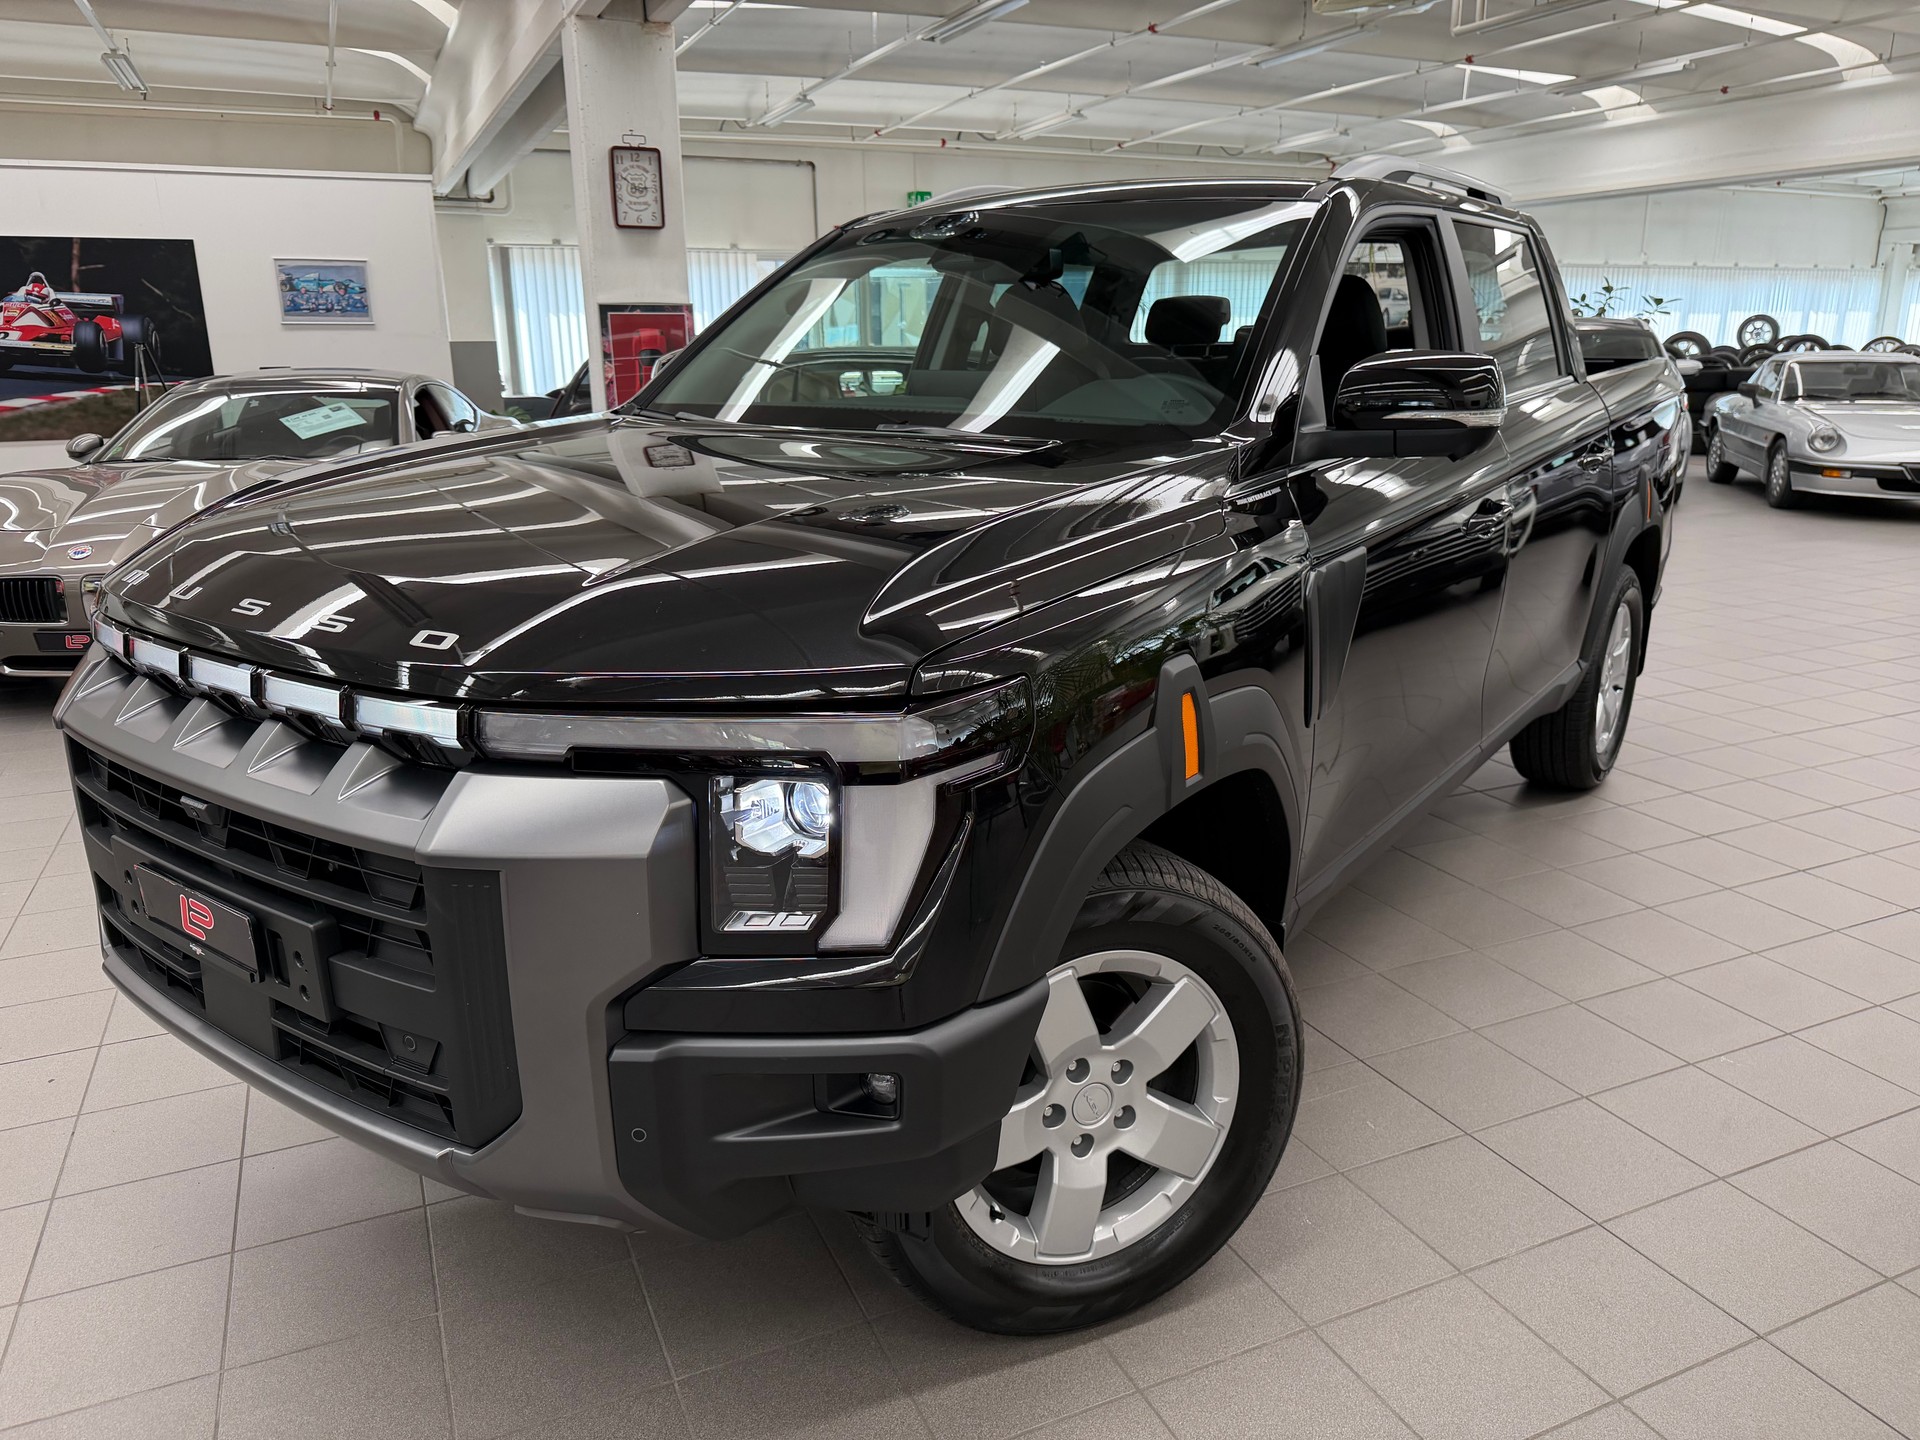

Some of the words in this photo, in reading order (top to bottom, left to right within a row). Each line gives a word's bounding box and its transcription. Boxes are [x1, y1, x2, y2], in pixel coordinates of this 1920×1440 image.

[630, 152, 640, 162] 12
[636, 214, 643, 224] 6
[121, 569, 460, 650] MUSSO
